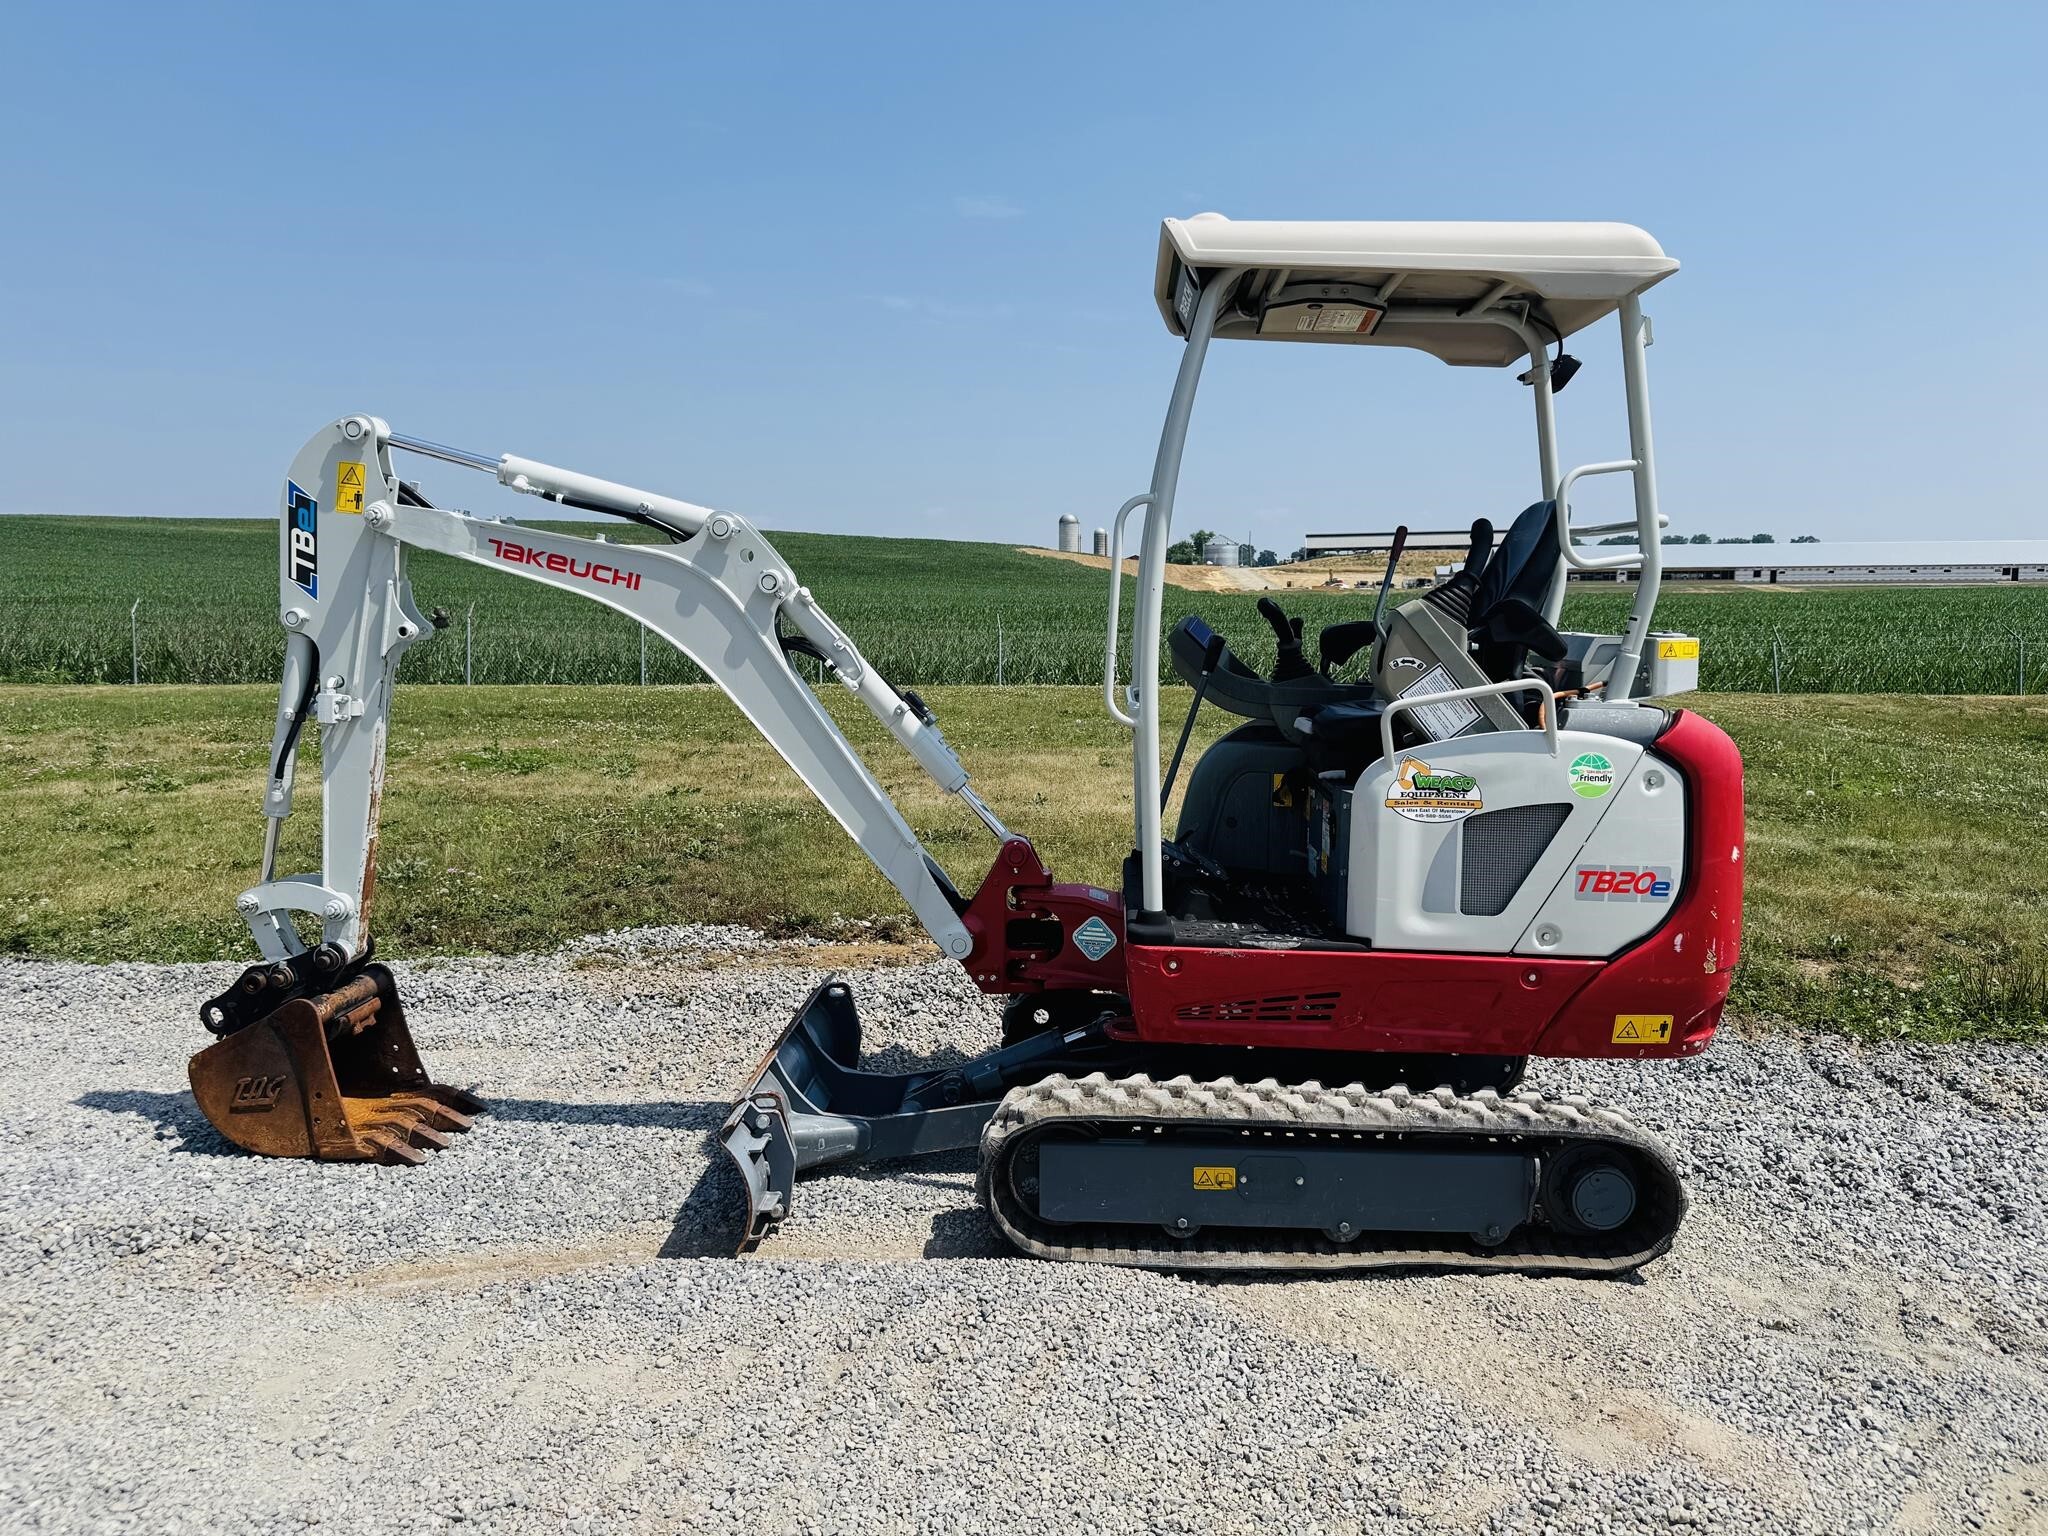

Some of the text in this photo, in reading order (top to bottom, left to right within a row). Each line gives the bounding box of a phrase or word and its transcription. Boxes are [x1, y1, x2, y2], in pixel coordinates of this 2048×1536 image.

[488, 538, 642, 591] TAKEUCHI
[1412, 771, 1477, 793] WEACO
[1579, 774, 1613, 784] Friendly
[1400, 791, 1468, 799] EQUIPMENT
[1577, 870, 1671, 897] TB20e
